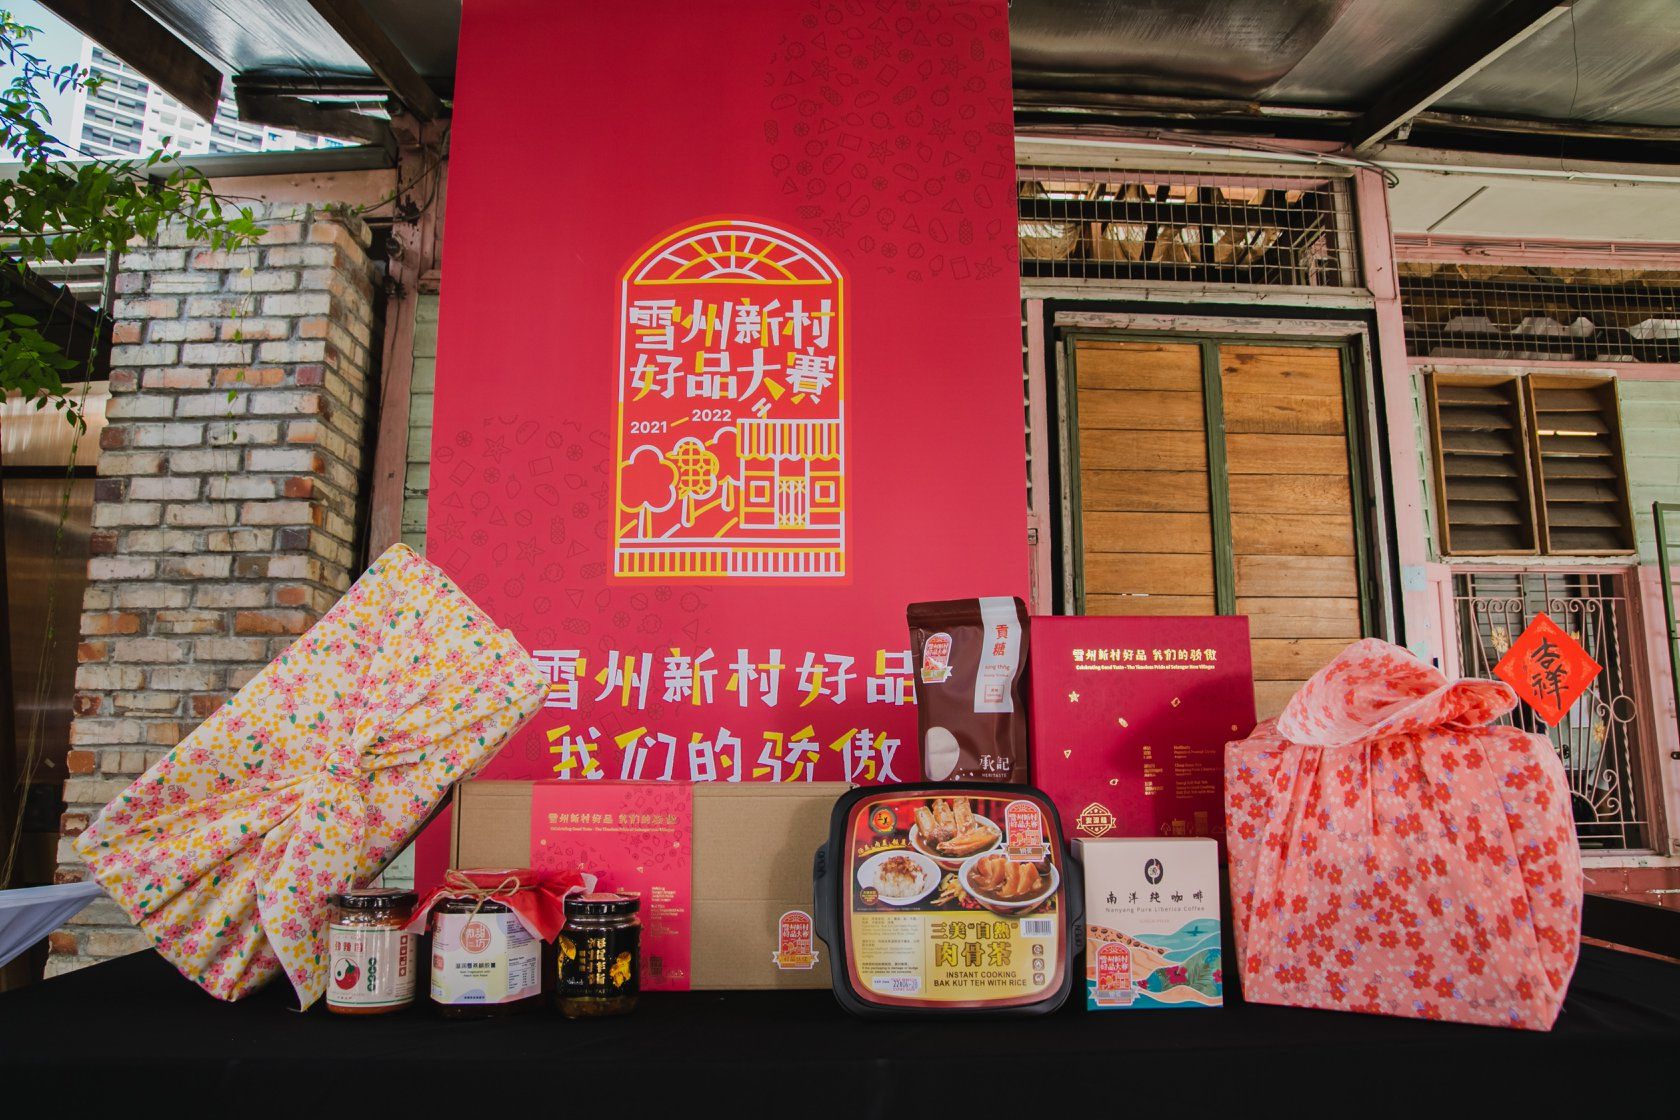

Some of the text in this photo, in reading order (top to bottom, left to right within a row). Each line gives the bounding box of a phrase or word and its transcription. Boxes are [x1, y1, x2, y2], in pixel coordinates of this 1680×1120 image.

[629, 297, 836, 351] 雪州新村
[629, 346, 836, 405] 好品大賽
[630, 408, 732, 434] 2021 2022
[992, 624, 1009, 657] 貢糖
[1072, 648, 1218, 662] 雪州新村好品 我们的骄傲
[532, 647, 918, 710] 雪州新村好品
[1530, 636, 1569, 710] 吉祥
[545, 723, 902, 783] 我们的骄傲
[979, 754, 1010, 772] 承記
[934, 941, 1012, 968] 肉骨茶
[933, 979, 950, 987] BAK
[952, 979, 968, 987] KUT
[970, 979, 985, 987] TEH
[946, 971, 1017, 979] INSTANT COOKING
